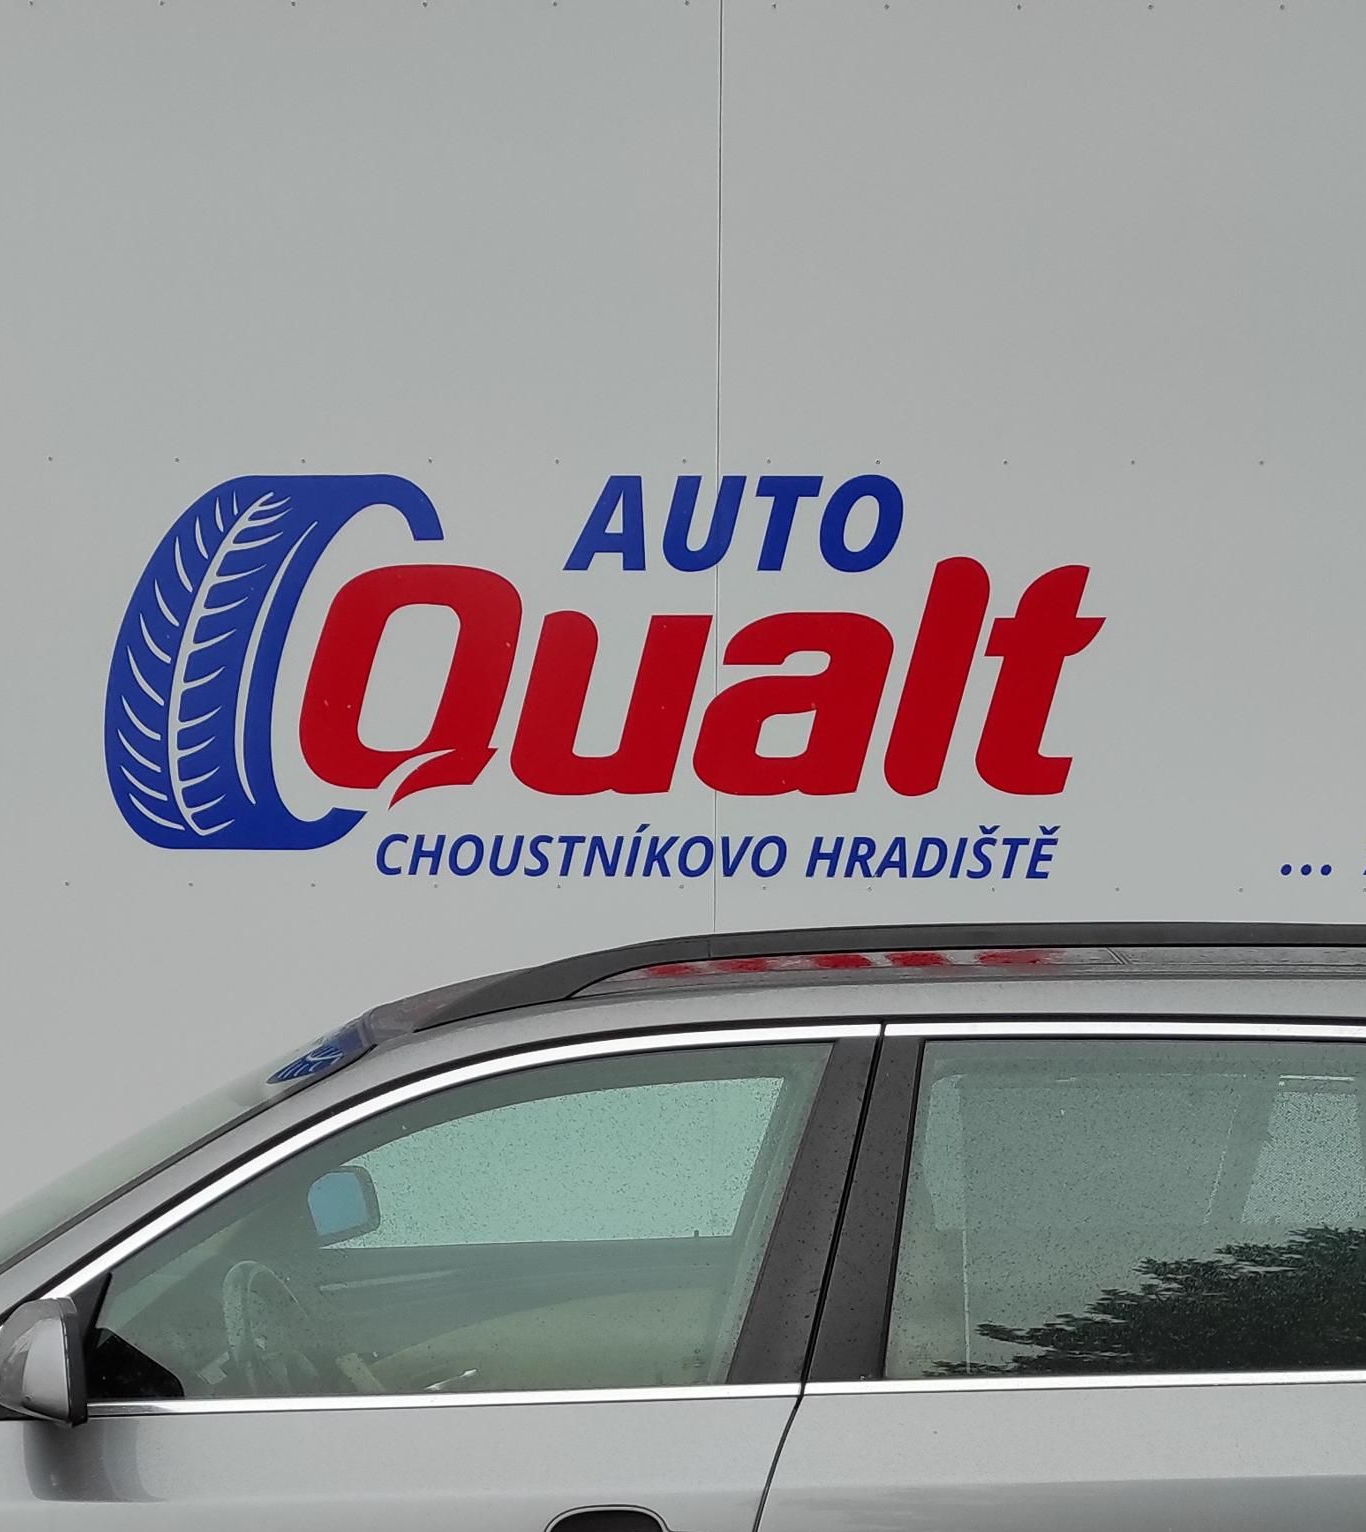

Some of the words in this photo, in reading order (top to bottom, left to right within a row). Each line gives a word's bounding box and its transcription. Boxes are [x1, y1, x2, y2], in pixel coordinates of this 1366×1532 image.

[564, 474, 904, 573] AUTO
[299, 556, 1106, 807] Qualt
[376, 823, 787, 878] CHOUSTNÍKOVO
[805, 825, 1060, 880] HRADIŠTĚ
